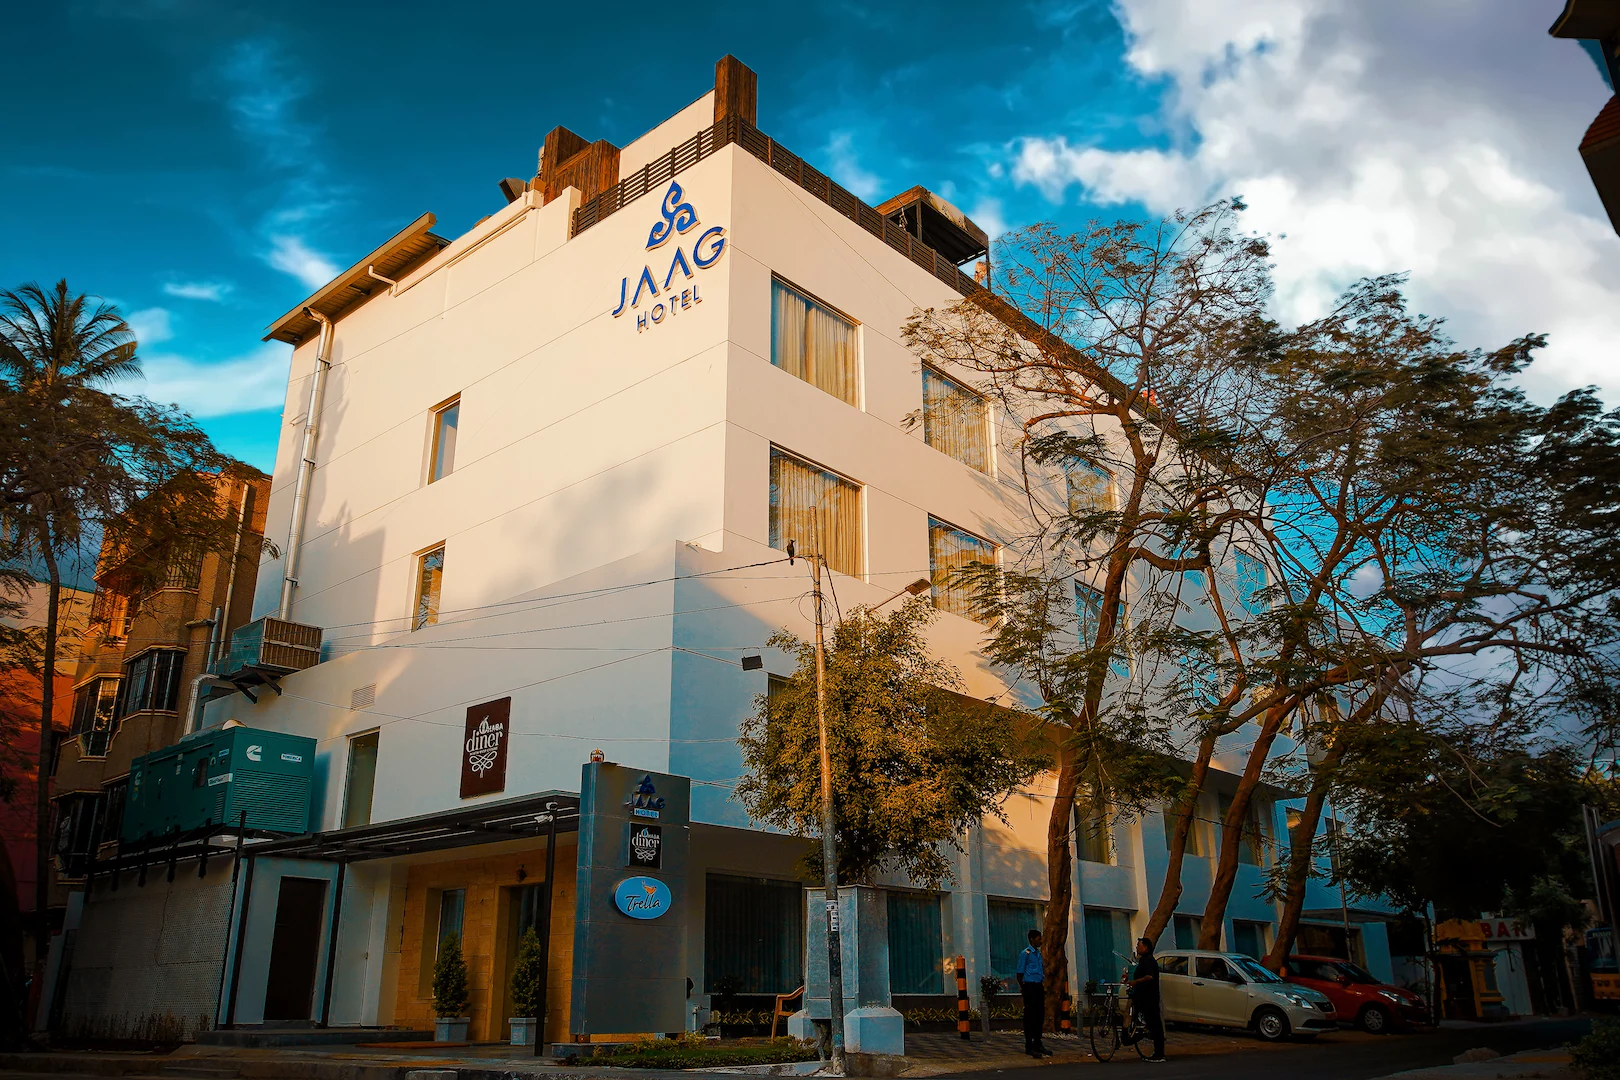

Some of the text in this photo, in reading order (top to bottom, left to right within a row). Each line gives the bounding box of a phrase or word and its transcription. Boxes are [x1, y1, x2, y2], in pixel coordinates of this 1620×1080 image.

[612, 226, 728, 318] JAAG
[636, 284, 703, 334] HOTEL
[466, 730, 503, 753] diner
[624, 793, 666, 809] JAAG
[631, 832, 660, 848] diner
[625, 894, 661, 912] Trella
